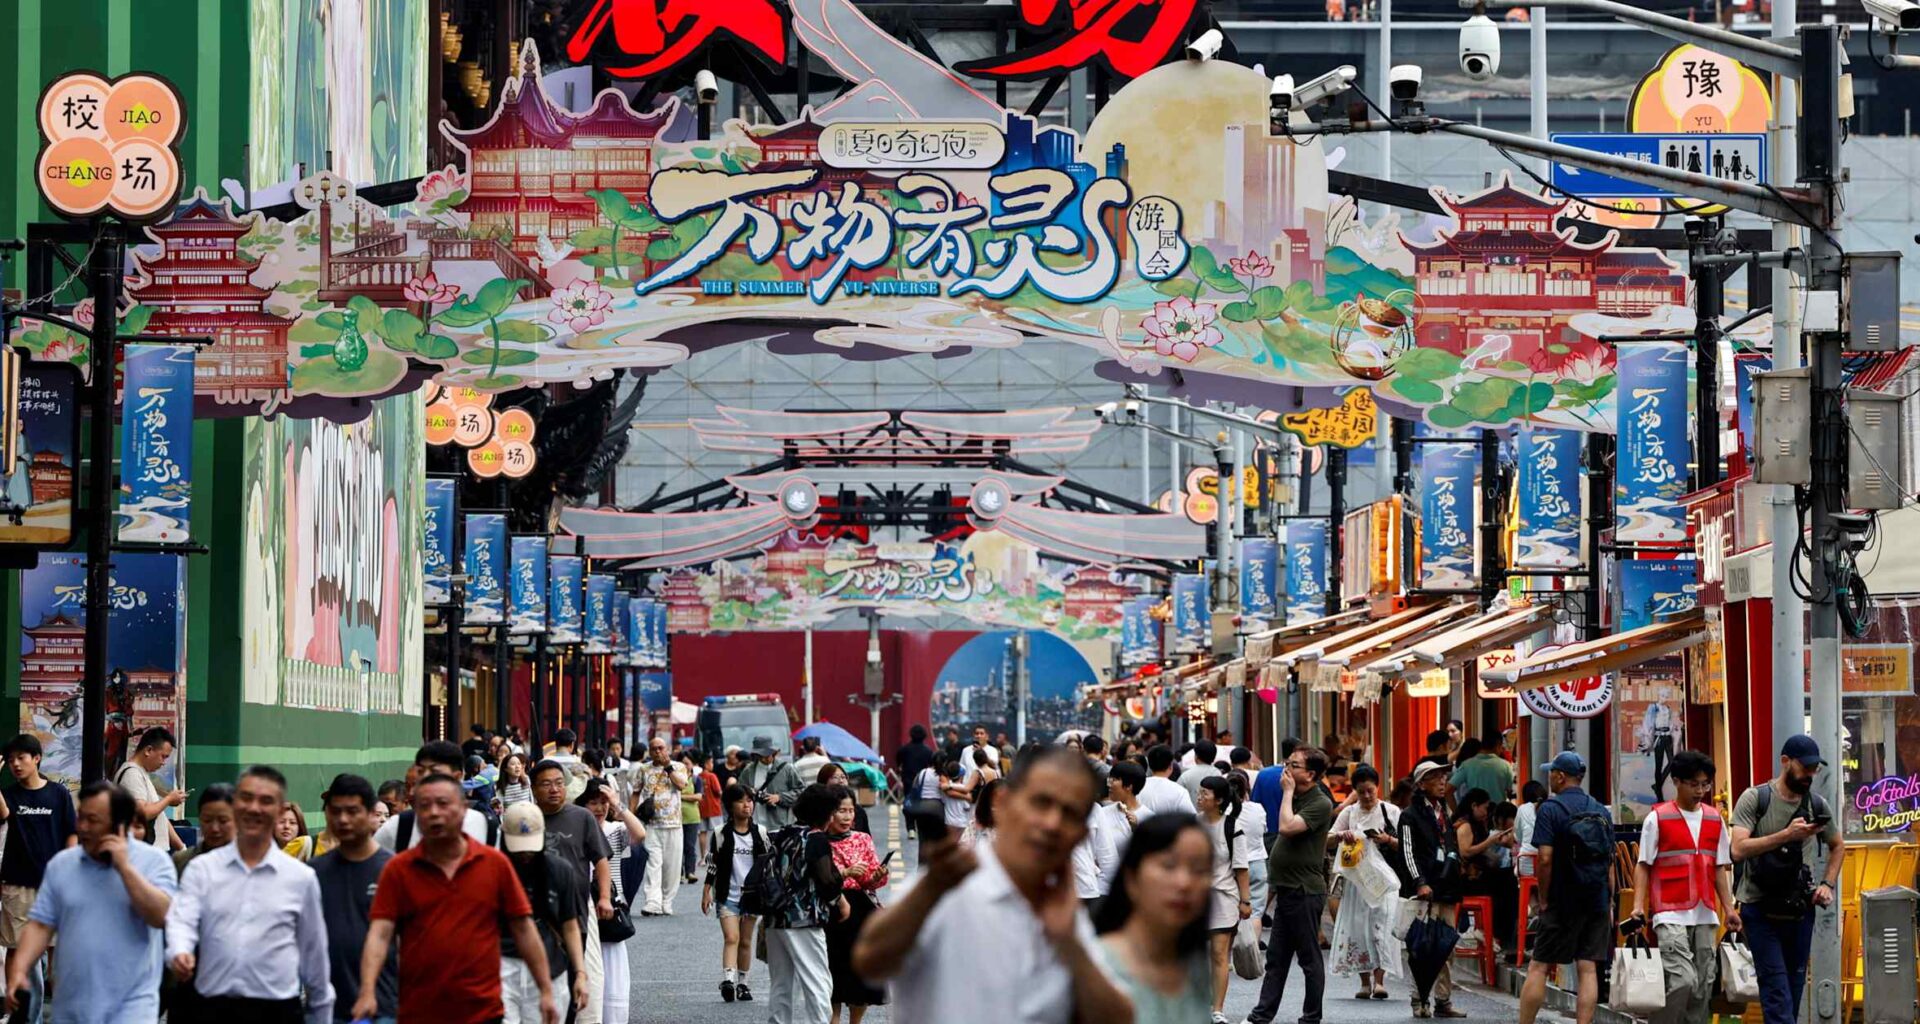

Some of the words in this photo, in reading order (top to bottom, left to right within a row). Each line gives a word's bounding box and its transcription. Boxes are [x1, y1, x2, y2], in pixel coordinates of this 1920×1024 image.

[1682, 59, 1723, 98] 豫
[62, 94, 99, 130] 校
[119, 110, 162, 124] JIAO
[1694, 116, 1712, 127] YU
[848, 128, 977, 164] 夏日奇幻夜
[46, 165, 113, 181] CHANG
[121, 157, 156, 191] 场
[636, 168, 1127, 303] 万物有灵
[1134, 201, 1178, 276] 游园会
[702, 281, 733, 294] THE
[738, 281, 806, 294] SUMMER
[842, 281, 939, 294] YU-NIVERSE
[134, 387, 174, 484] 万物有灵
[426, 418, 456, 429] HANG
[460, 413, 480, 433] 场
[504, 424, 527, 433] JIAO
[1628, 388, 1668, 484] 万物有灵
[471, 453, 504, 461] CHANG
[507, 447, 525, 465] 场
[1529, 434, 1564, 518] 万物有灵
[1431, 475, 1461, 547] 万物有灵
[472, 537, 494, 591] 万物有灵
[1293, 542, 1317, 596] 万物有灵
[819, 557, 976, 602] 万物有灵
[1559, 700, 1598, 713] WELFARE
[16, 805, 53, 816] Dickies
[1888, 802, 1898, 815] &
[733, 847, 753, 856] dida
